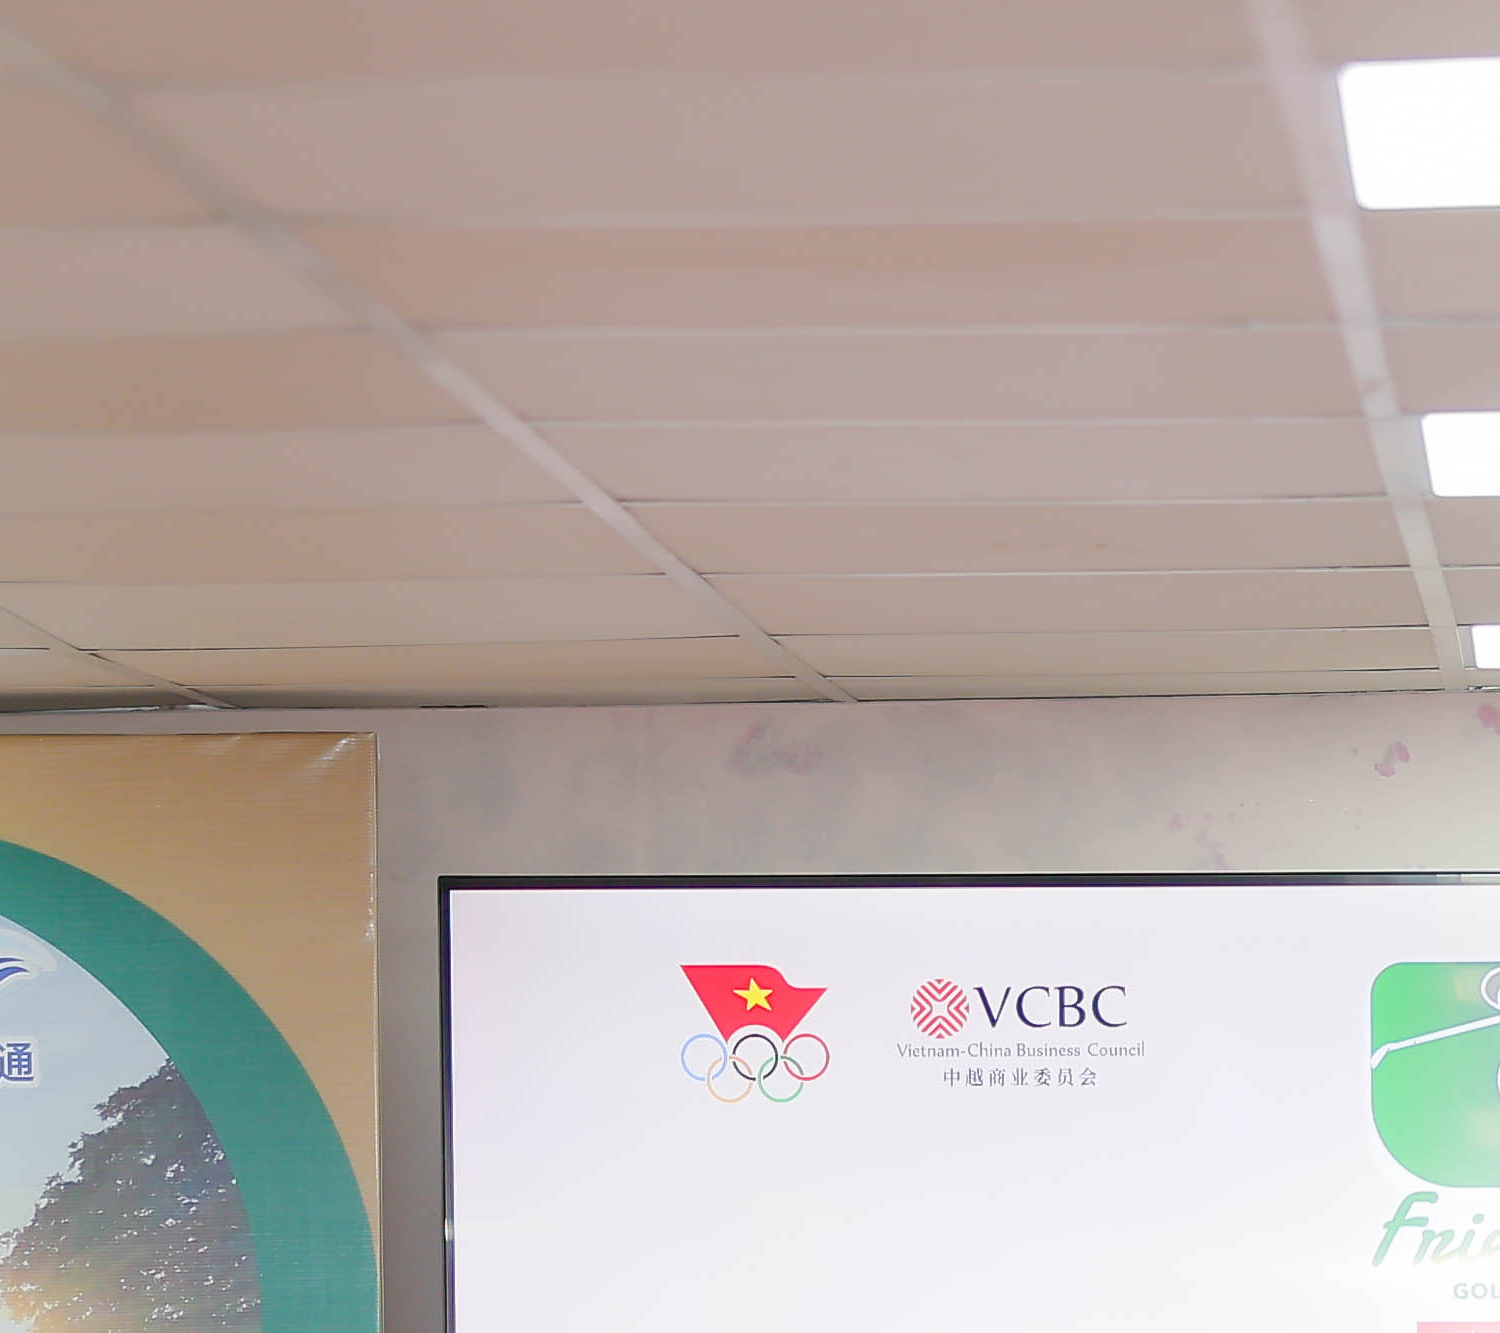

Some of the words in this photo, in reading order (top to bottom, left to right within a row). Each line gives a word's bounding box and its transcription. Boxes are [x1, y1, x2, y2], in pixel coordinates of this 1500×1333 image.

[973, 985, 1128, 1028] VCBC
[1017, 1041, 1081, 1058] Business
[1088, 1040, 1146, 1058] Council
[943, 1066, 1097, 1087] 中越商业委员会
